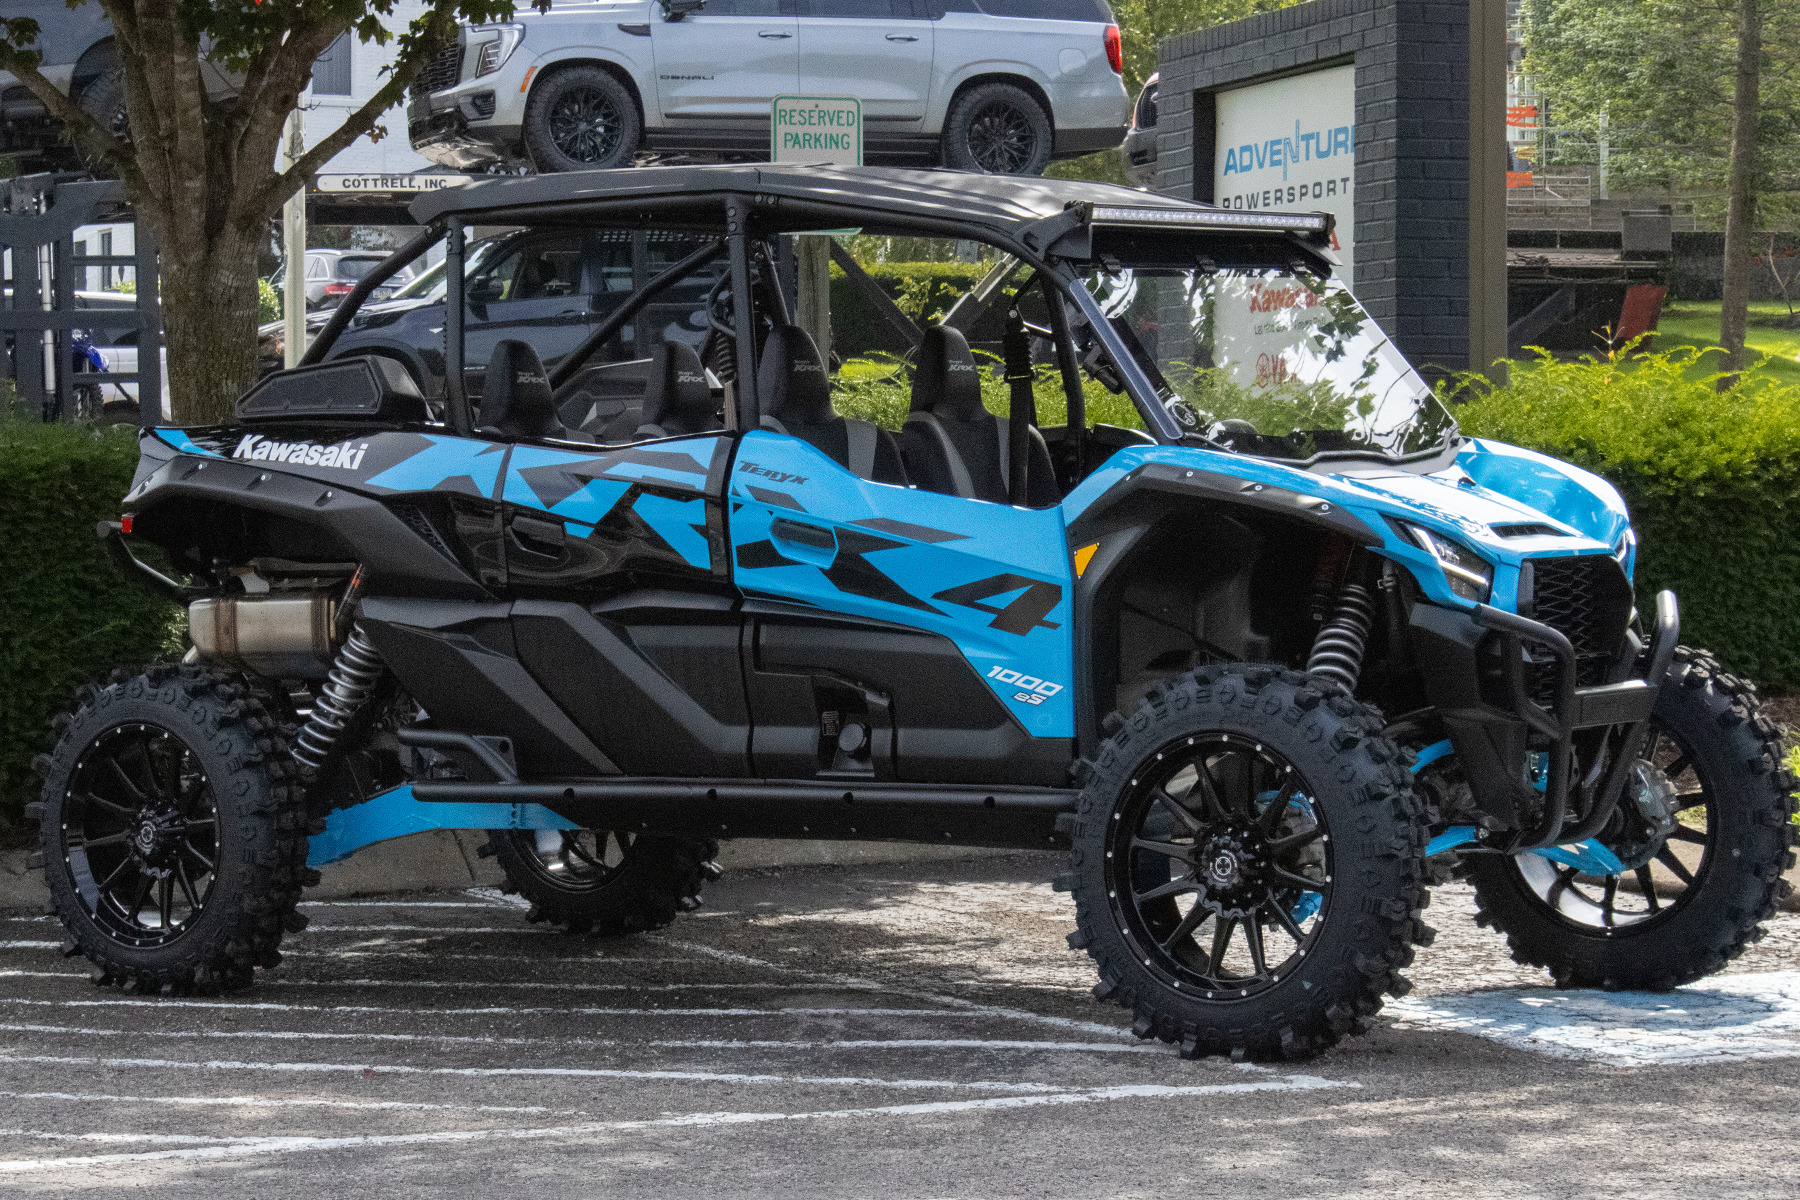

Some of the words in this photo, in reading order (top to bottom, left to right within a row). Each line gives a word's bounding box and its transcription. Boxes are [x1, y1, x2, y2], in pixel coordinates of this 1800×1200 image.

[778, 108, 856, 127] RESERVED
[783, 132, 851, 150] PARKING
[341, 178, 421, 190] COTTRELL,
[232, 434, 369, 470] Kawasaki
[986, 665, 1064, 696] 1000
